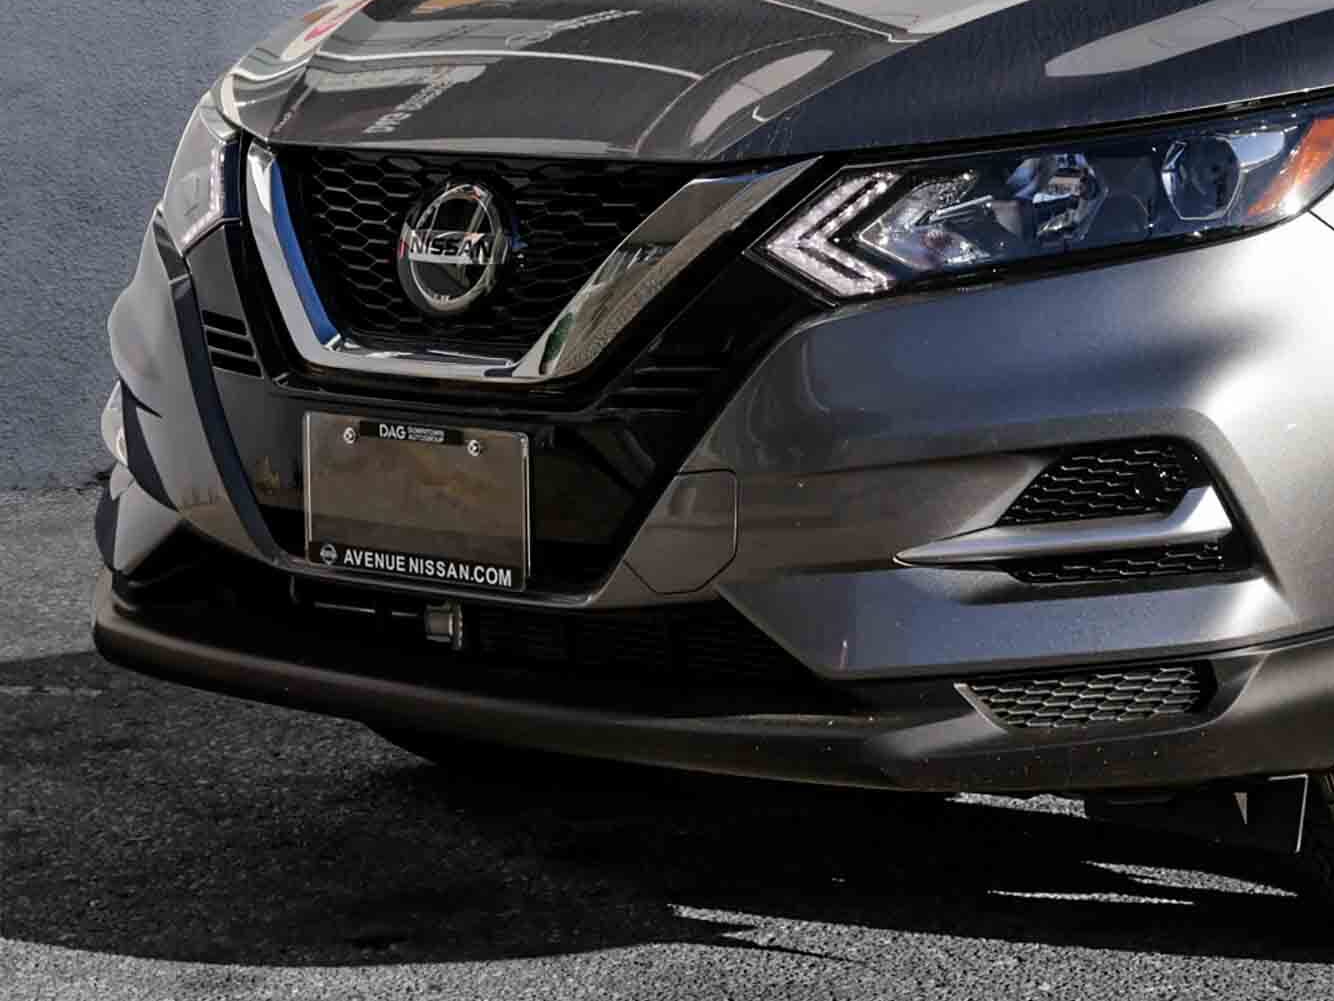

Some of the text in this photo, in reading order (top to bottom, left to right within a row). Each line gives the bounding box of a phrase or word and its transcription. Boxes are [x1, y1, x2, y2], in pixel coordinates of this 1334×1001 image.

[410, 231, 493, 264] NISSAN
[379, 423, 407, 440] DAG
[343, 549, 512, 587] AVENUE NISSAN.COM
